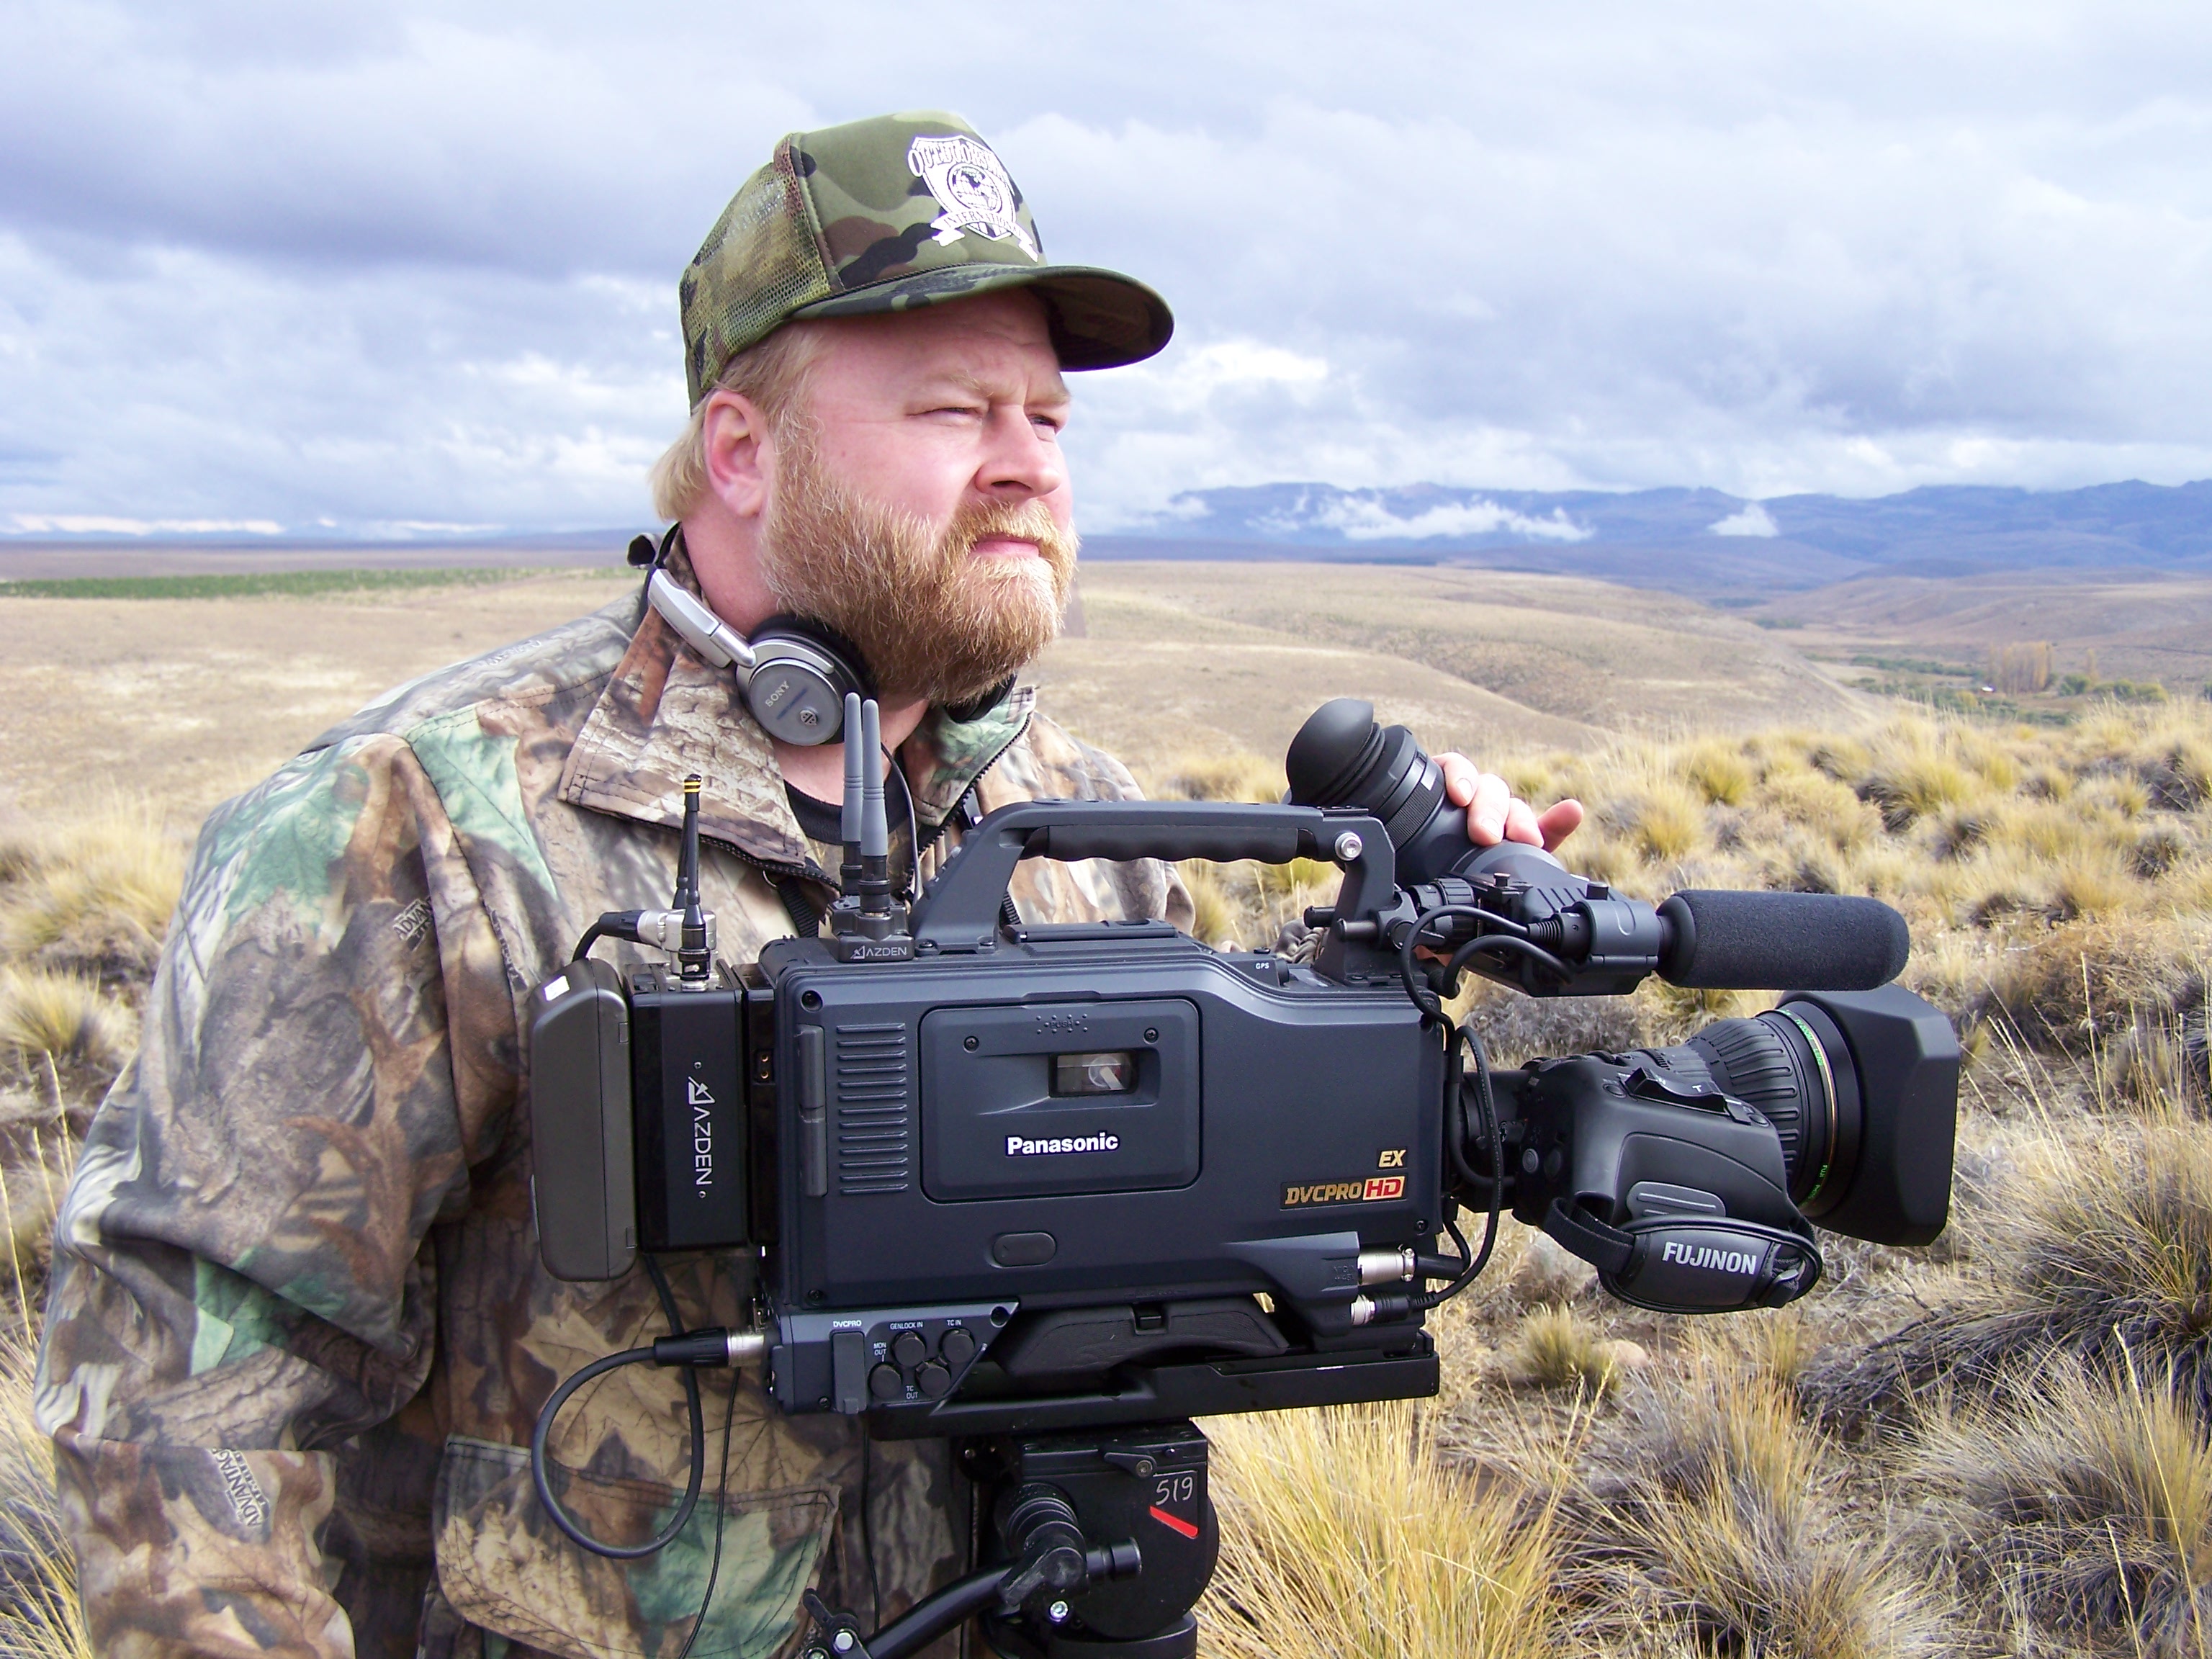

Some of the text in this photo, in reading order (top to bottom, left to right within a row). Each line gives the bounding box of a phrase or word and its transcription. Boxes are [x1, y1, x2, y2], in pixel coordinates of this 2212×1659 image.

[765, 680, 790, 708] SONY
[866, 947, 907, 957] AZDEN
[1050, 1020, 1073, 1028] PUSH
[693, 1106, 713, 1185] AZDEN
[1007, 1132, 1119, 1155] Panasonic
[1378, 1149, 1407, 1167] EX
[1285, 1178, 1402, 1205] DVCPRO HD
[1662, 1241, 1757, 1274] FUJINON
[1156, 1476, 1193, 1505] 519
